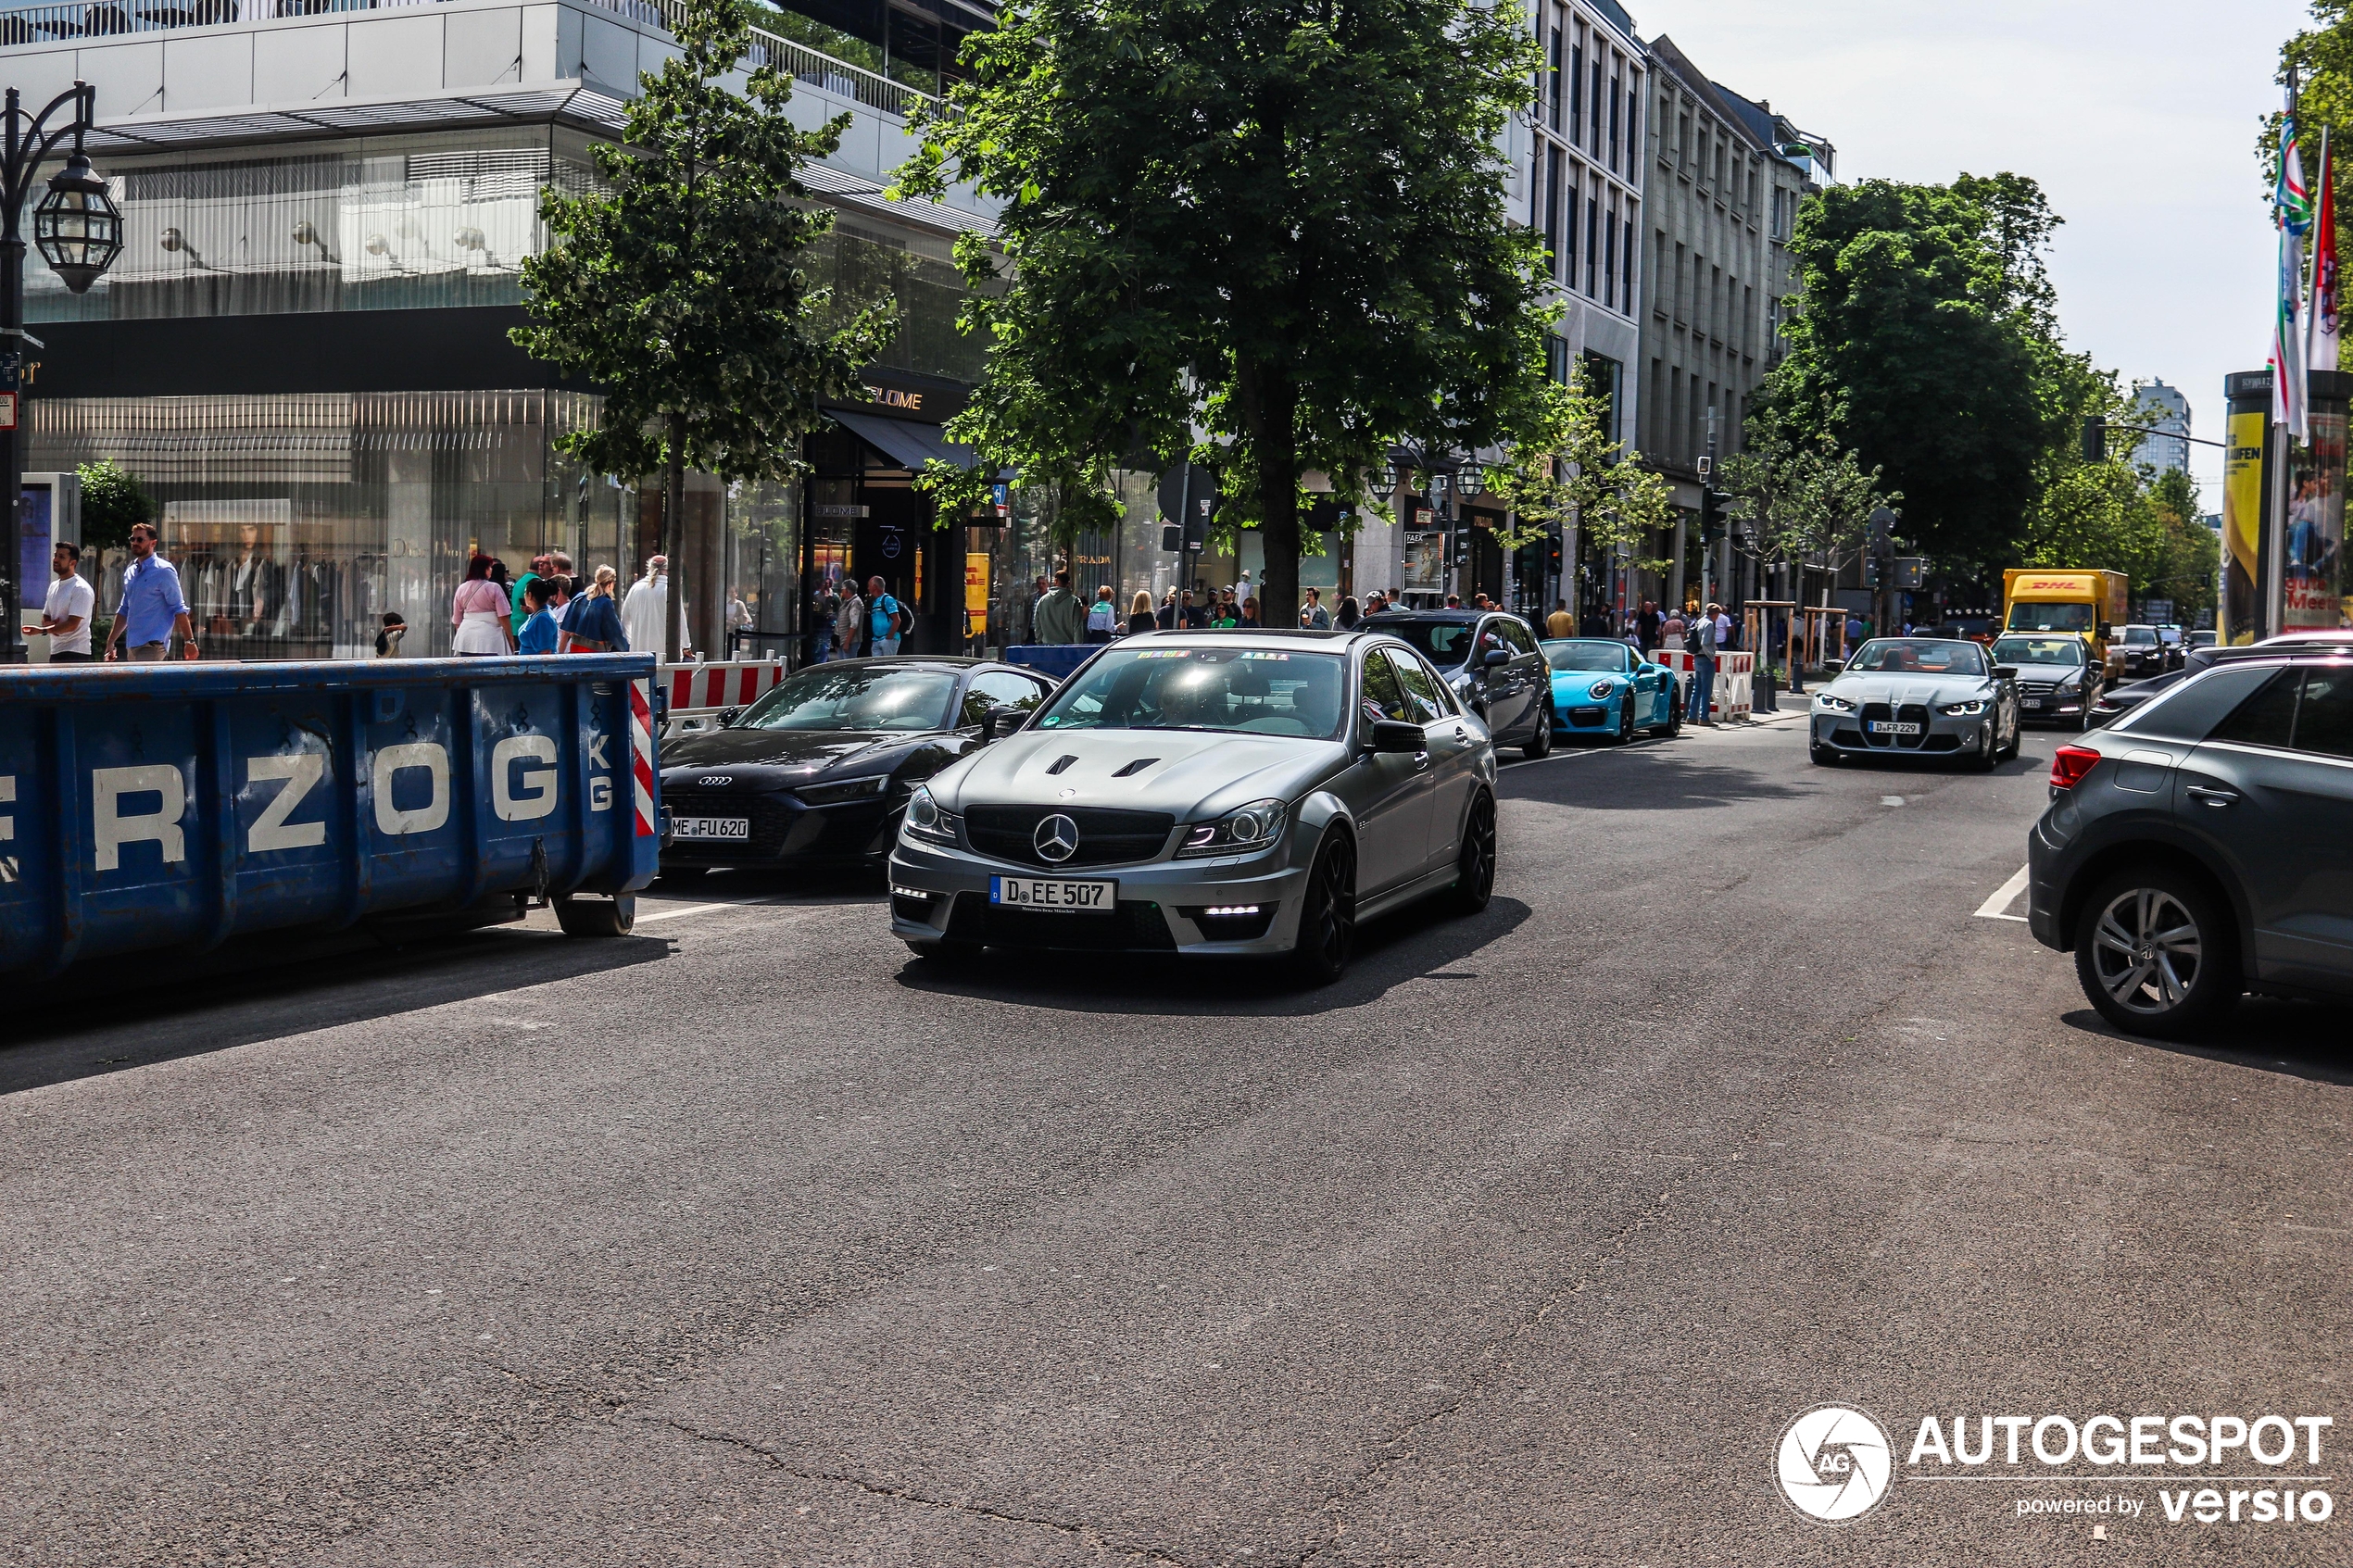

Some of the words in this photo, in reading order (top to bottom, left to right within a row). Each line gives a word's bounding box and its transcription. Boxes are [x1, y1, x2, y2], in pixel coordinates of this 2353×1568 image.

[817, 507, 859, 517] BLOME
[1876, 722, 1882, 732] D
[1886, 723, 1898, 733] FR
[1900, 724, 1916, 733] 229
[0, 735, 558, 883] RZOG
[673, 820, 689, 835] ME
[698, 820, 717, 836] FU
[720, 820, 747, 836] 620
[1007, 880, 1019, 901] D
[1032, 883, 1059, 904] EE
[1063, 884, 1103, 906] 507
